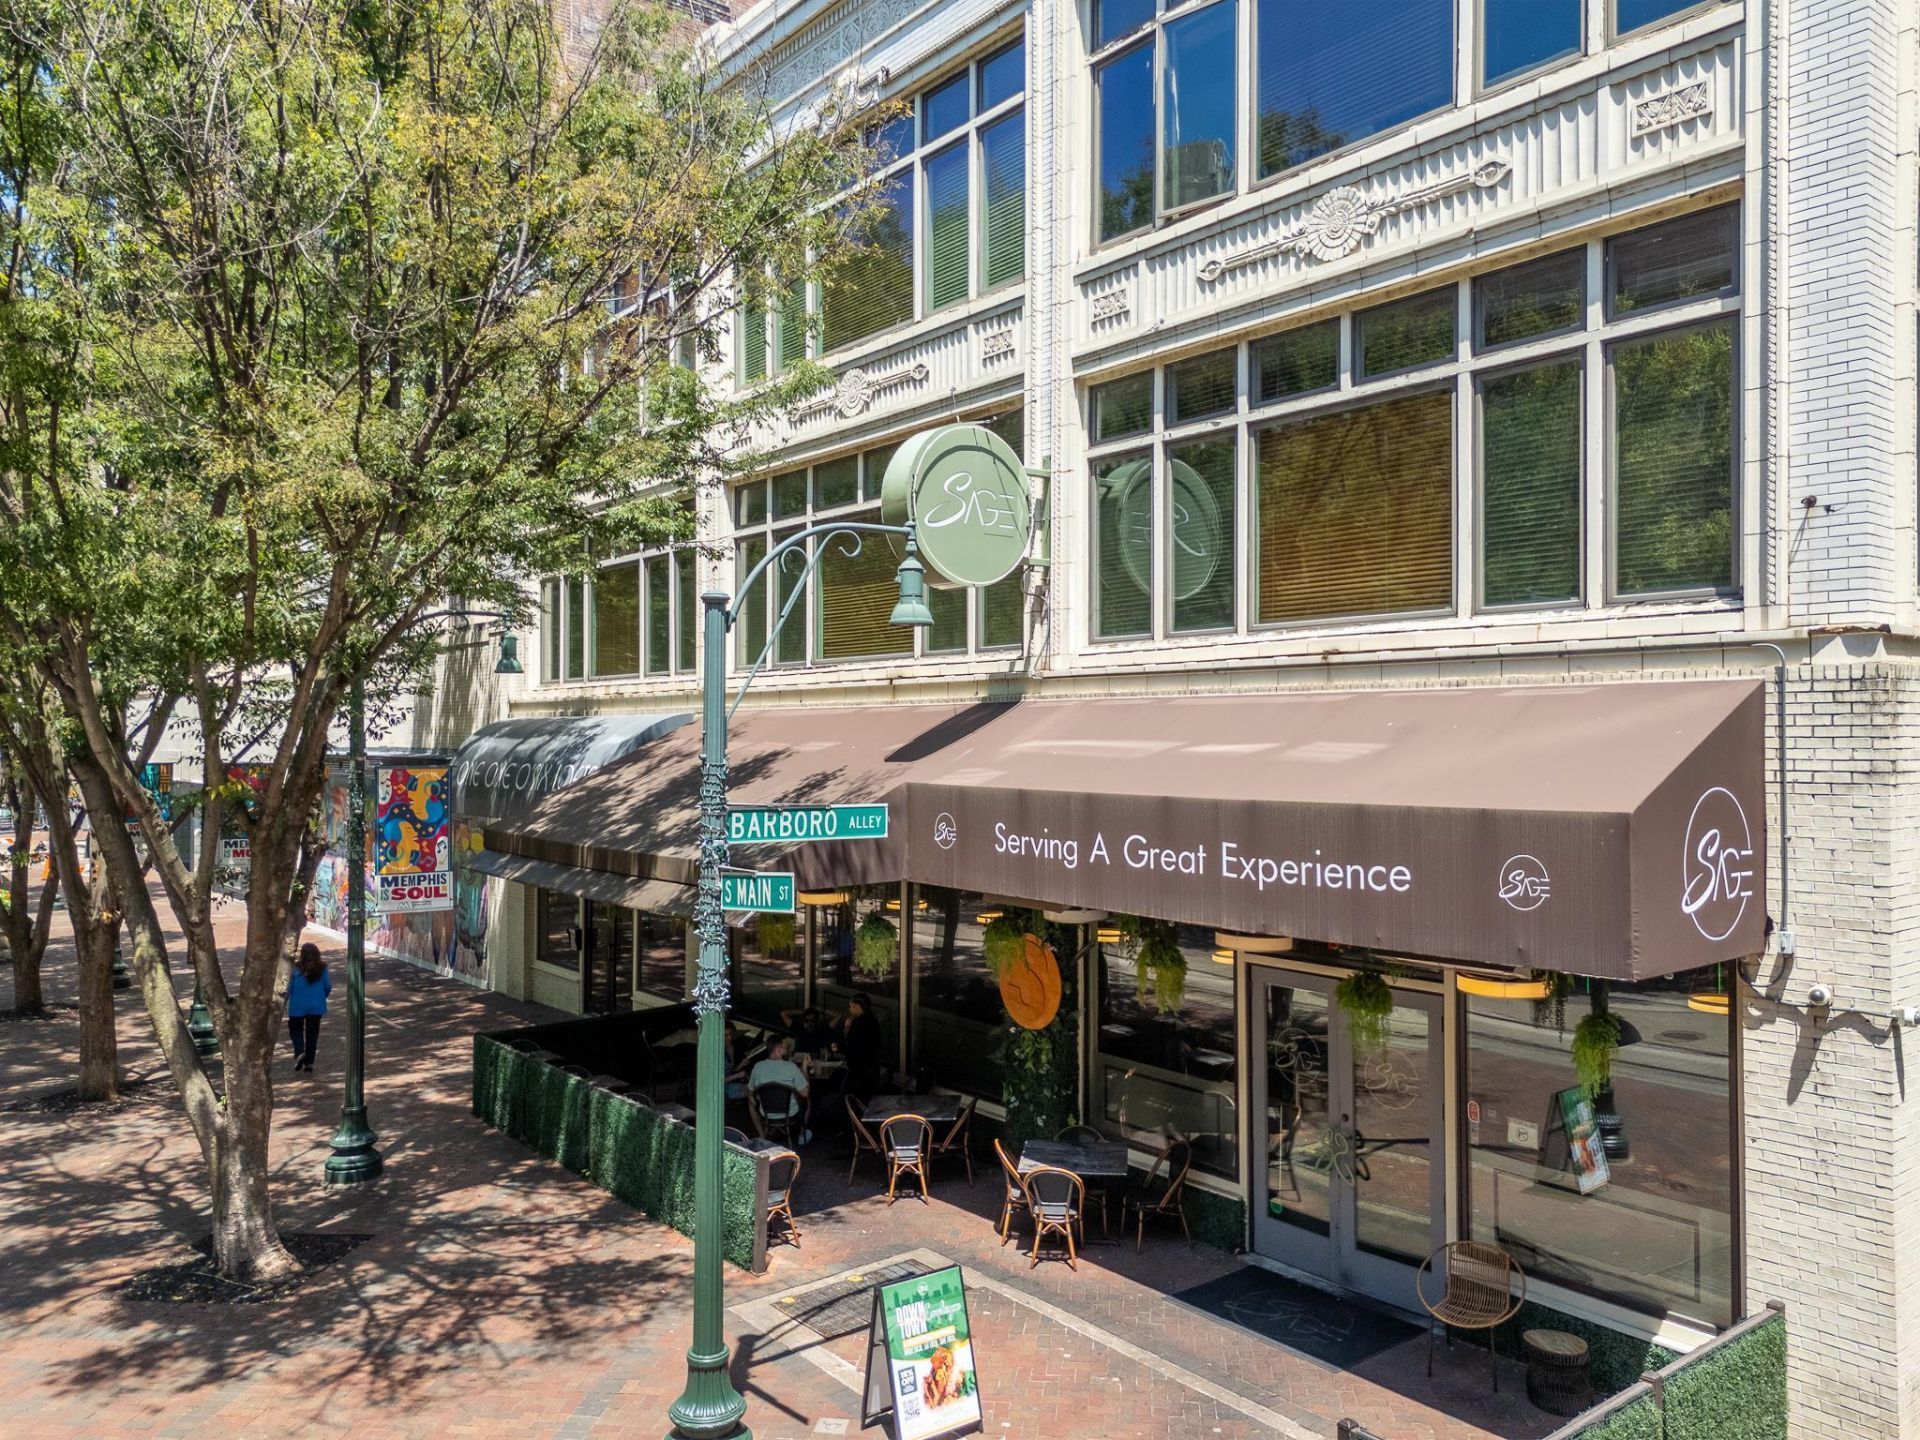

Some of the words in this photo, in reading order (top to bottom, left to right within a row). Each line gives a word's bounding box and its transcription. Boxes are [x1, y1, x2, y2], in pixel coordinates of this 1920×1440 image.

[924, 472, 1015, 529] SAGE
[456, 760, 485, 787] ONE
[731, 810, 837, 839] BARBORO
[849, 815, 882, 829] ALLEY
[994, 822, 1078, 869] Serving
[1089, 832, 1111, 865] A
[1123, 834, 1207, 875] Great
[1221, 841, 1412, 892] Experience
[1681, 828, 1753, 914] SAGE
[380, 873, 447, 888] MEMPHIS
[380, 888, 390, 901] IS
[391, 885, 448, 901] SOUL
[725, 882, 732, 903] S
[737, 879, 772, 907] MAIN
[779, 885, 789, 901] ST
[1498, 869, 1550, 898] SAGE
[1364, 1063, 1419, 1096] SAGE
